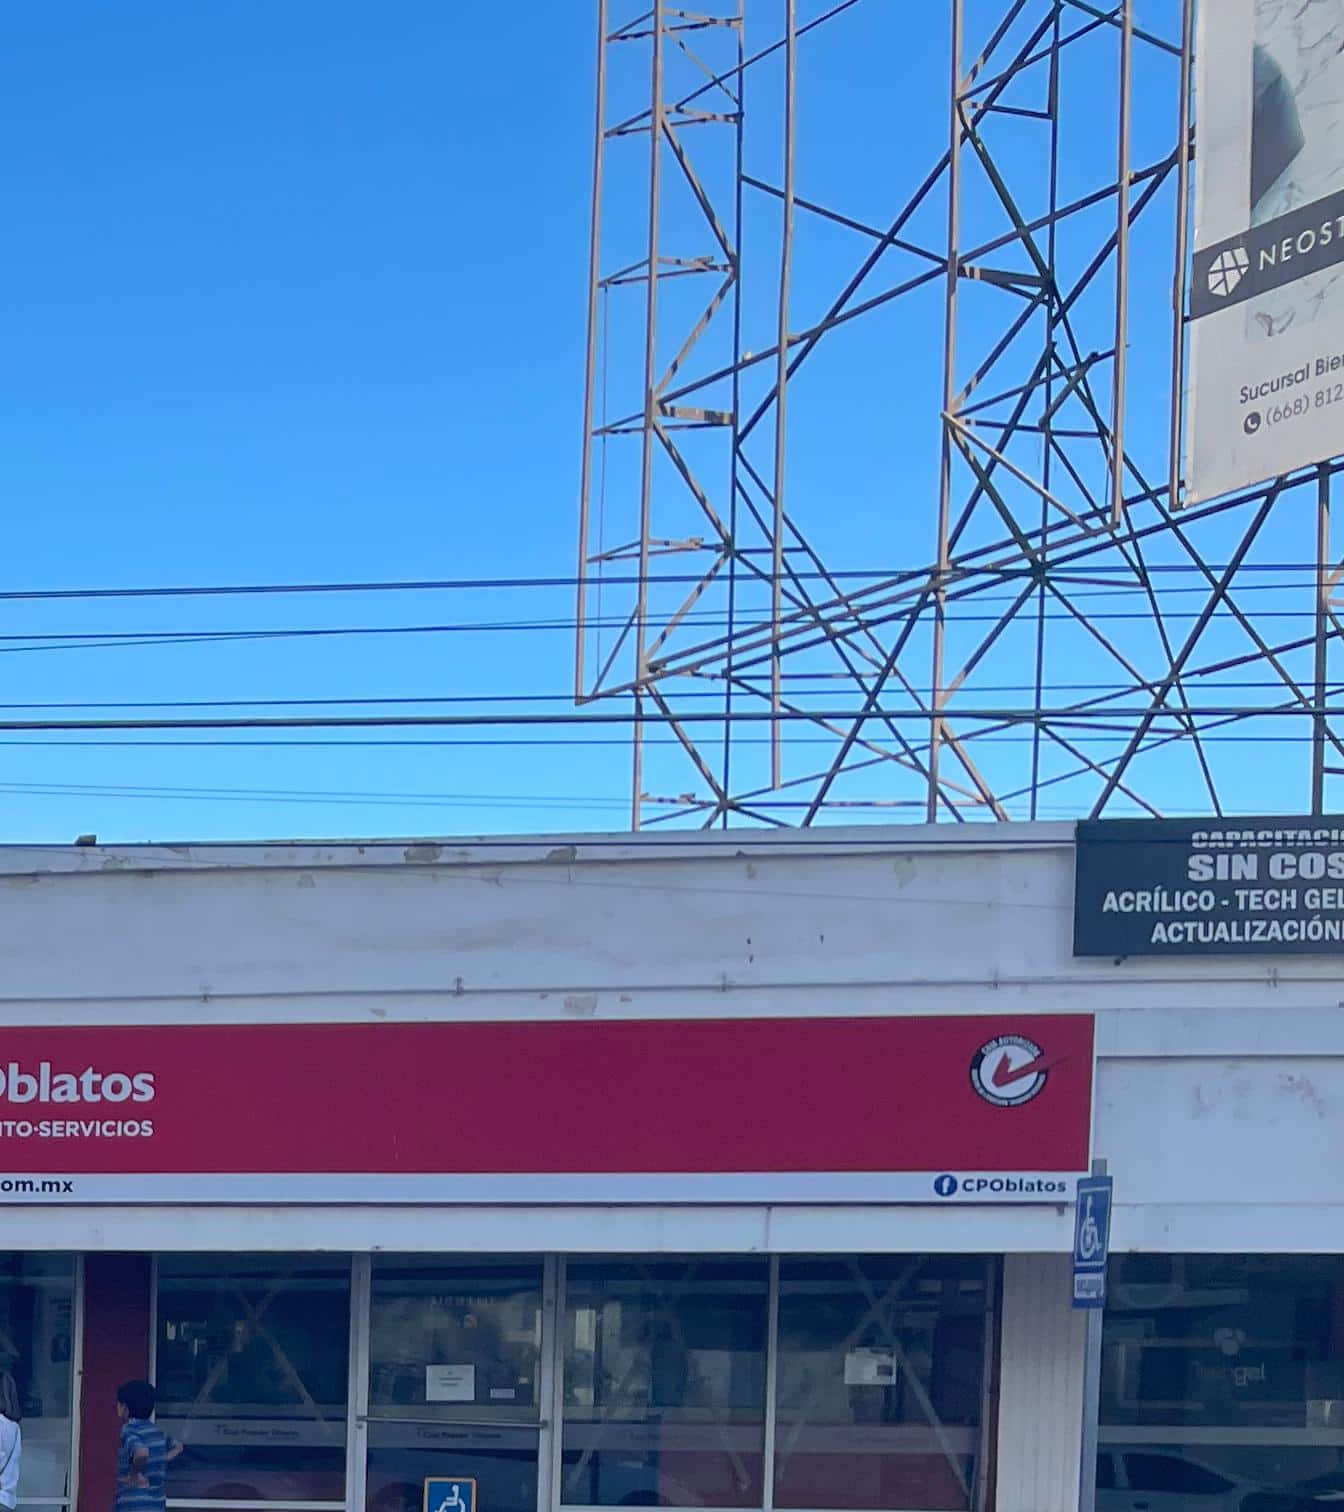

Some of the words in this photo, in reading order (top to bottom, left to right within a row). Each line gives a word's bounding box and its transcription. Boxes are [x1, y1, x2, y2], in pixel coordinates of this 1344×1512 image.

[1239, 363, 1310, 404] Sucursal
[1315, 354, 1344, 377] Bie
[1265, 394, 1310, 426] (668)
[1188, 853, 1259, 882] SIN
[1269, 852, 1344, 881] COS
[1102, 884, 1216, 912] ACRÍLICO
[1235, 888, 1296, 911] TECH
[1151, 914, 1344, 944] ACTUALIZACIÓN
[962, 1178, 1067, 1193] CPOblatos
